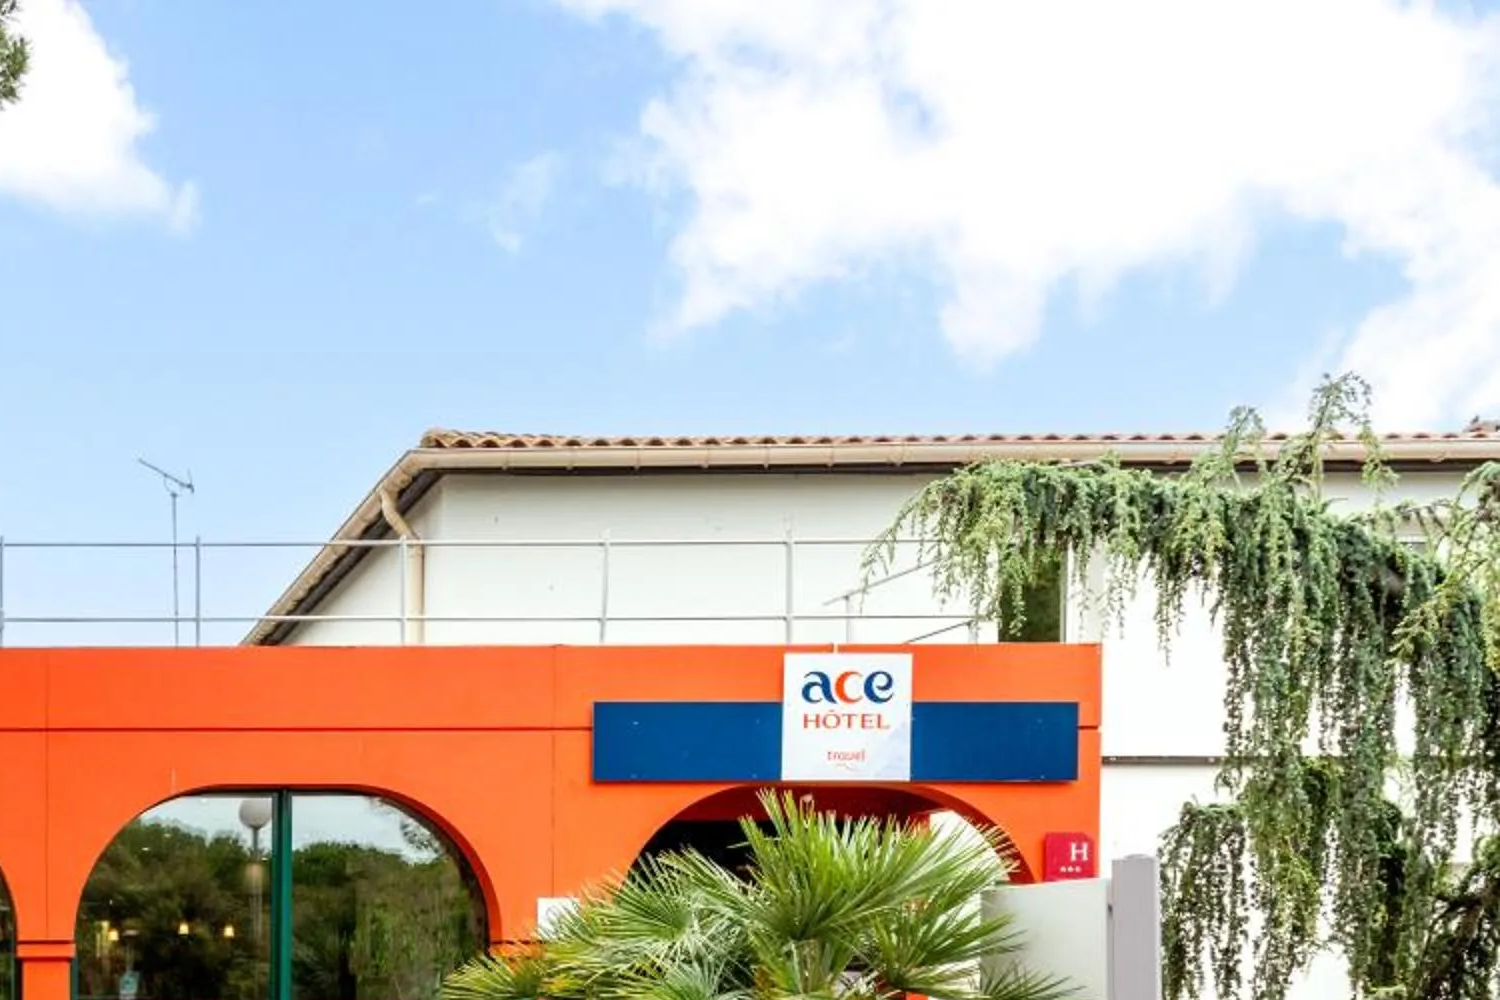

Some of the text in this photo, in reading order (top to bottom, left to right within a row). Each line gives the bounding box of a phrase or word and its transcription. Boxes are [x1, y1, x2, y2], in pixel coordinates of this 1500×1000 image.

[801, 670, 895, 704] ace
[802, 709, 891, 730] HÔTEL
[1070, 842, 1089, 862] H
